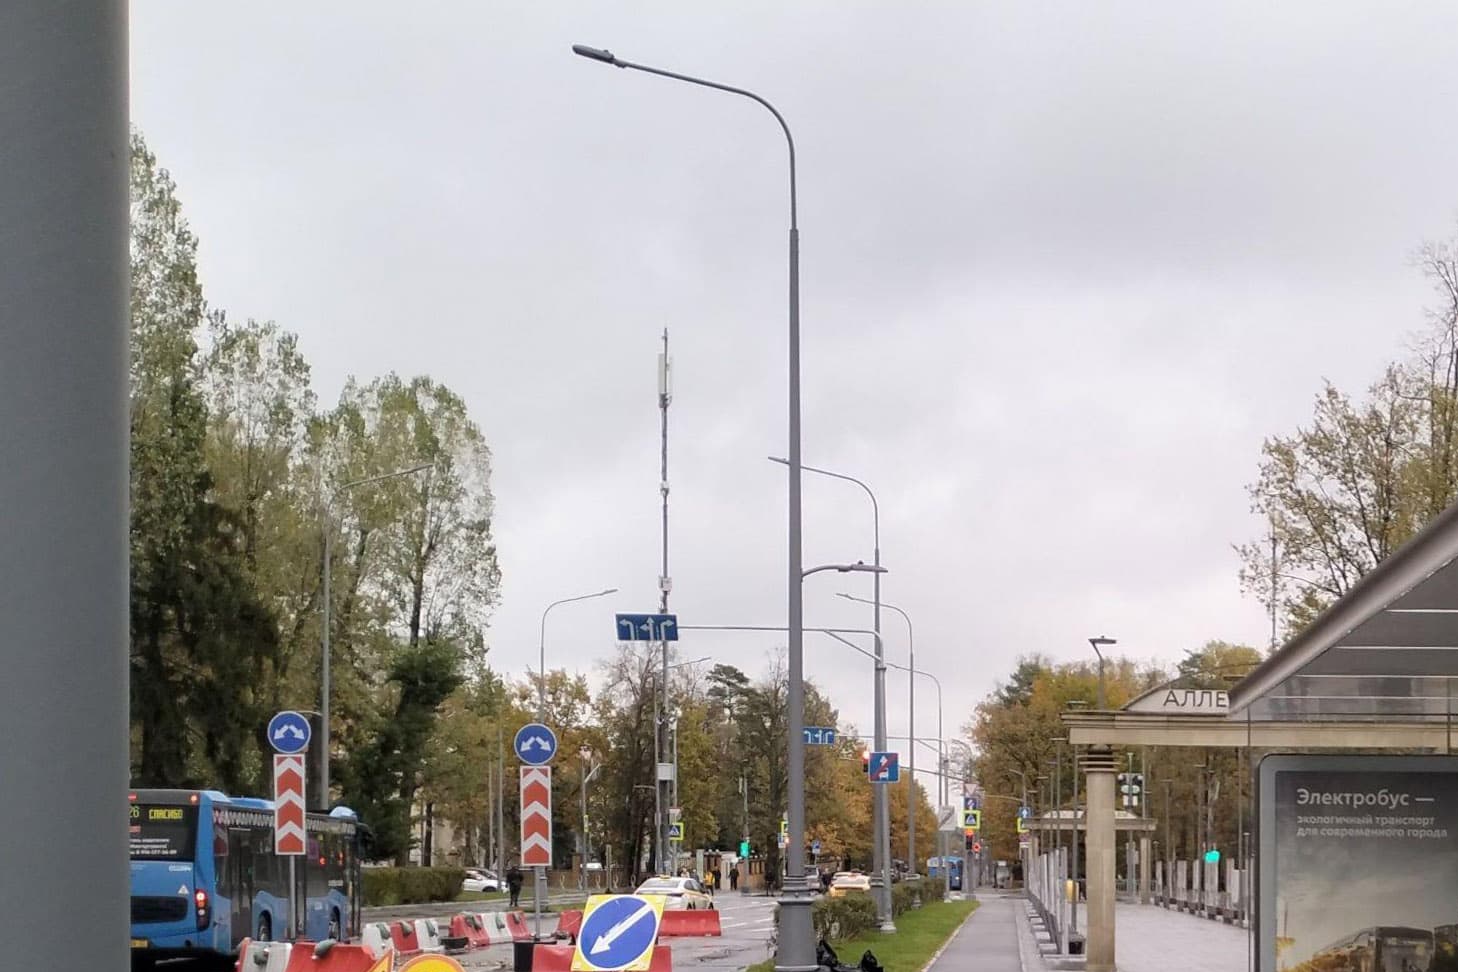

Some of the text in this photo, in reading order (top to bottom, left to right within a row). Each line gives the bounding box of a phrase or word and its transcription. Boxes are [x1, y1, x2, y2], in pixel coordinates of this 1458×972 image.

[1296, 788, 1410, 809] Электробус
[148, 808, 184, 820] СПАСИБО
[1296, 815, 1435, 827] экологичный транспорт
[1296, 827, 1448, 839] для современного города
